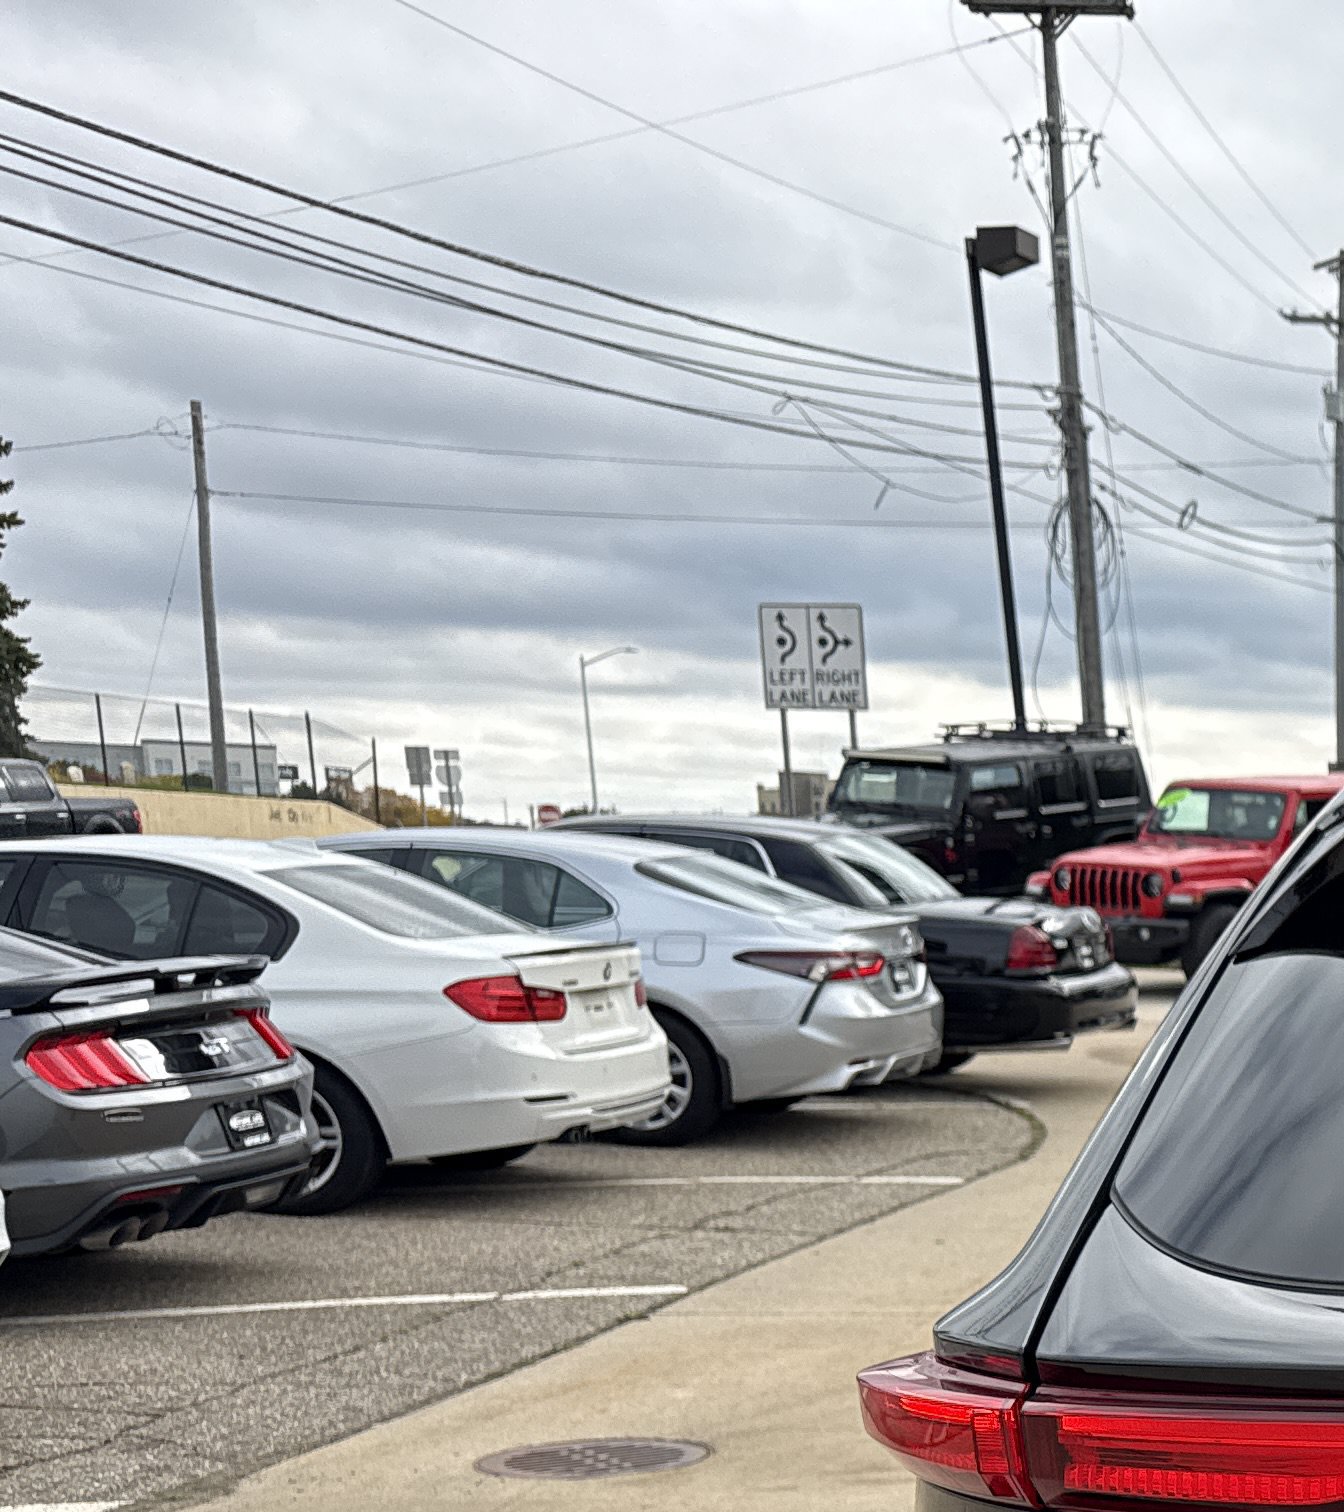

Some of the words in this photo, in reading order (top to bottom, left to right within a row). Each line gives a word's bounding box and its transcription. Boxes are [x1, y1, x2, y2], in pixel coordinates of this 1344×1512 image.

[768, 668, 807, 686] LEFT
[815, 669, 860, 686] RIGHT
[769, 689, 810, 703] LANE
[817, 689, 860, 703] LANE
